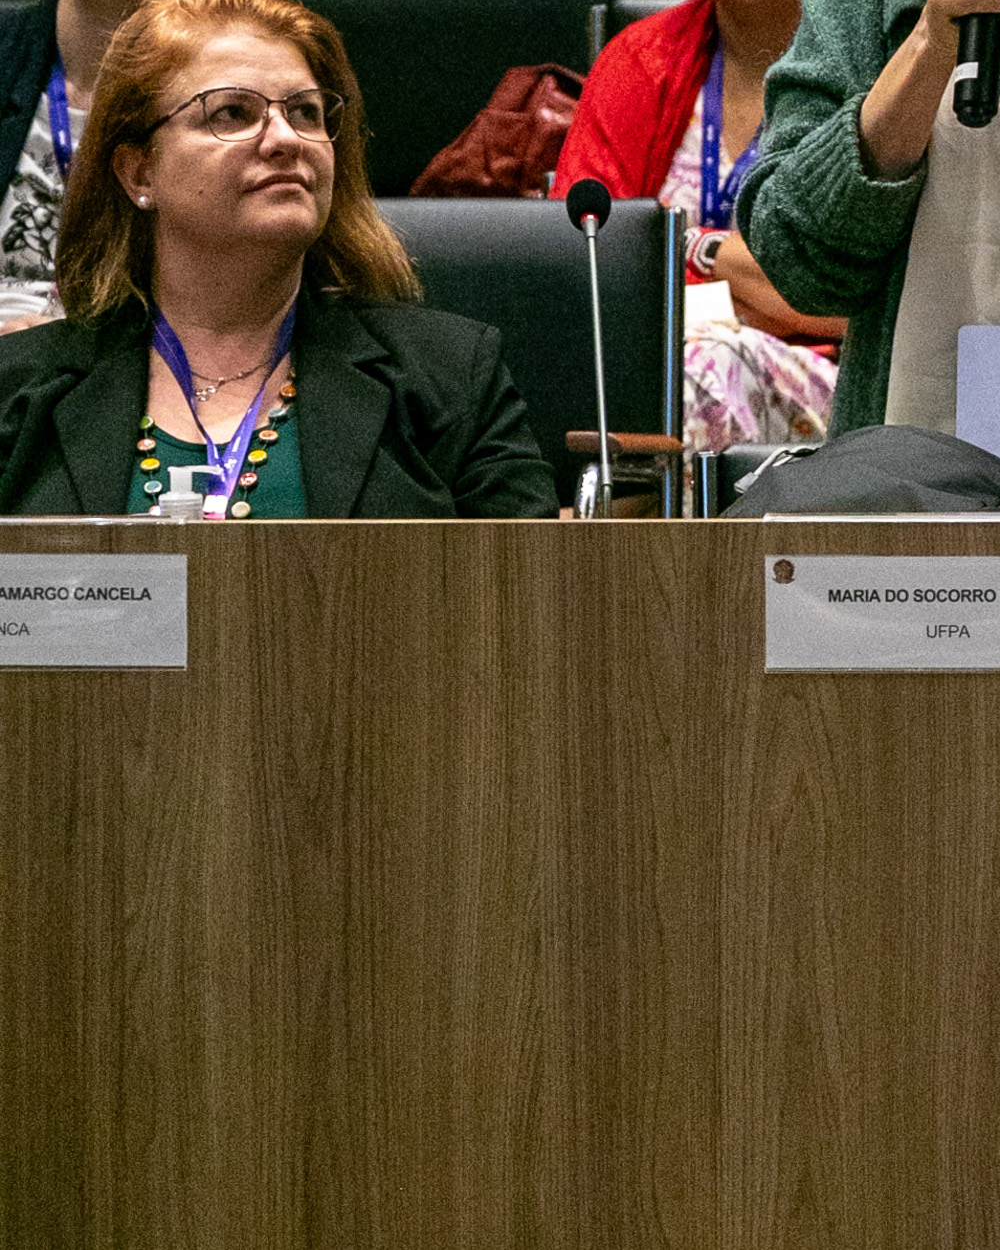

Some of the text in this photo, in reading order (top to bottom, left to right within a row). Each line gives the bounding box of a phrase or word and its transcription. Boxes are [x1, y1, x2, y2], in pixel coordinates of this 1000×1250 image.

[0, 586, 152, 601] AMARGO CANCELA
[828, 588, 881, 602] MARIA
[885, 588, 909, 602] DO
[913, 588, 997, 603] SOCORRO
[926, 624, 971, 639] UFPA
